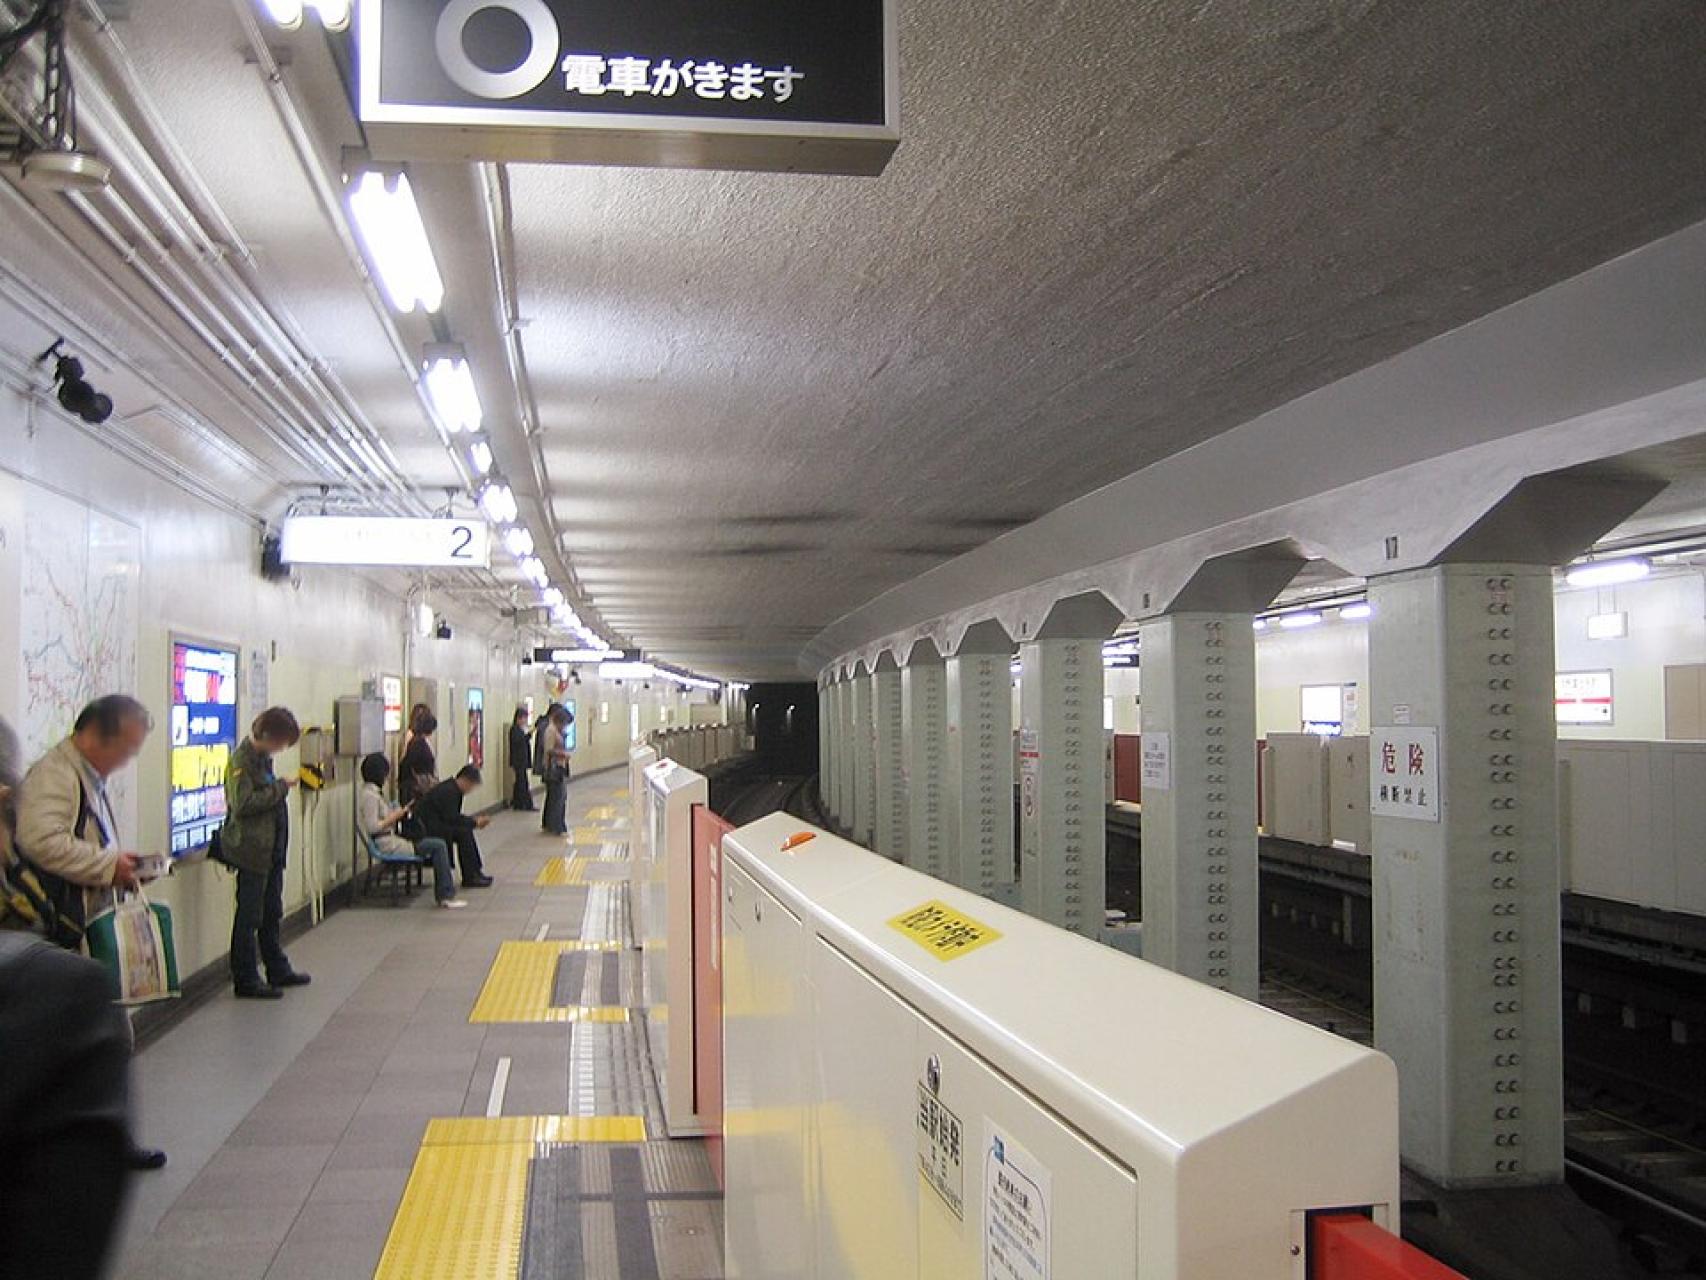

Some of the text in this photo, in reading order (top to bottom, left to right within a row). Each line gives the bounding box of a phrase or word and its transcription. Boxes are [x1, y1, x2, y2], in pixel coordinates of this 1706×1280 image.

[561, 54, 805, 102] 電車がきます
[451, 526, 473, 558] 2
[1382, 741, 1424, 775] 危険
